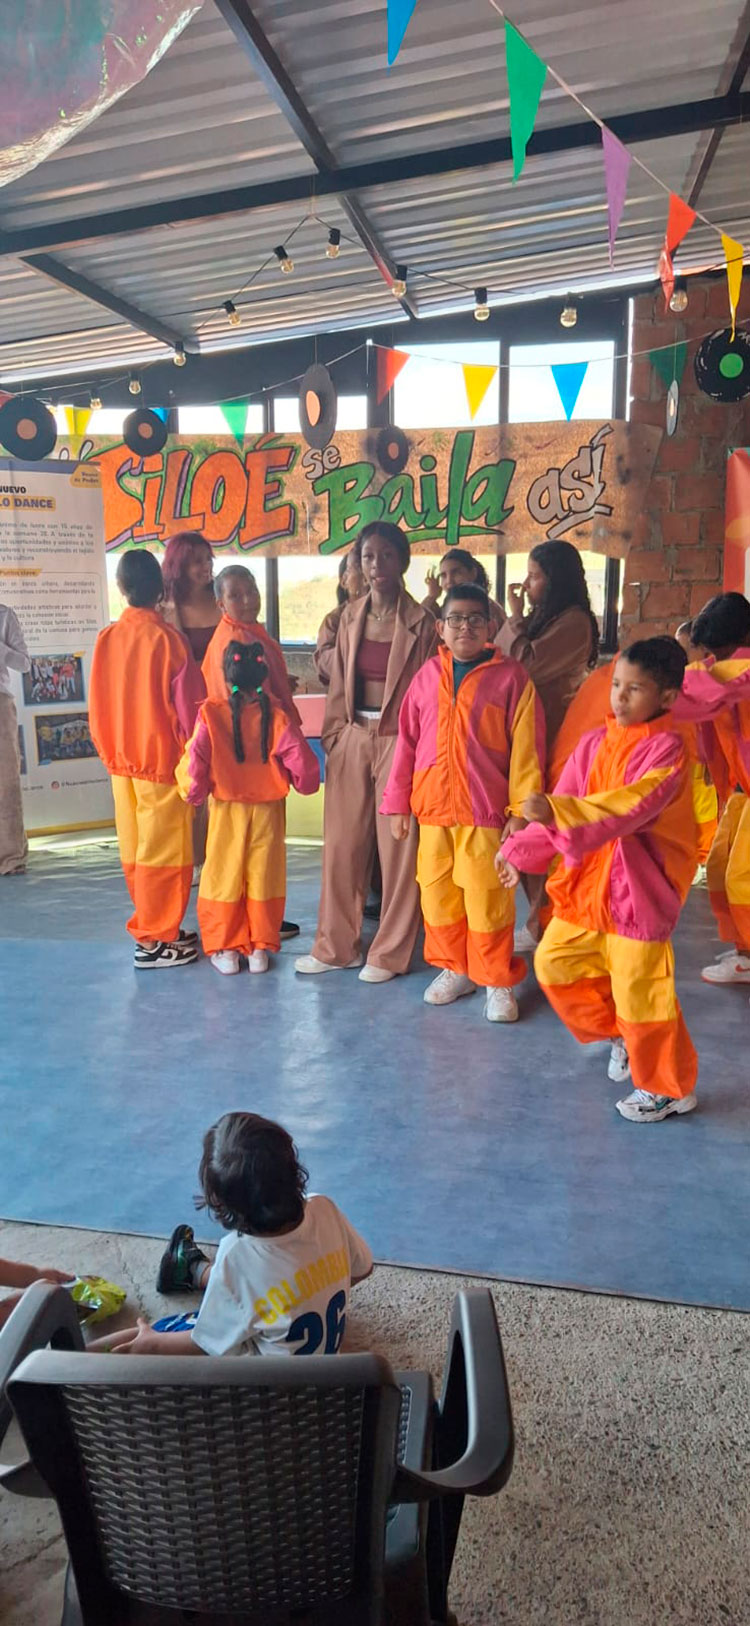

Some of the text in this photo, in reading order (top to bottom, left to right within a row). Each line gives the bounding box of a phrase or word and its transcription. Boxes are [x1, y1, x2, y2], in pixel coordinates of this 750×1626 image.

[302, 446, 341, 480] se
[14, 498, 53, 508] DANCE
[312, 430, 517, 555] Baila
